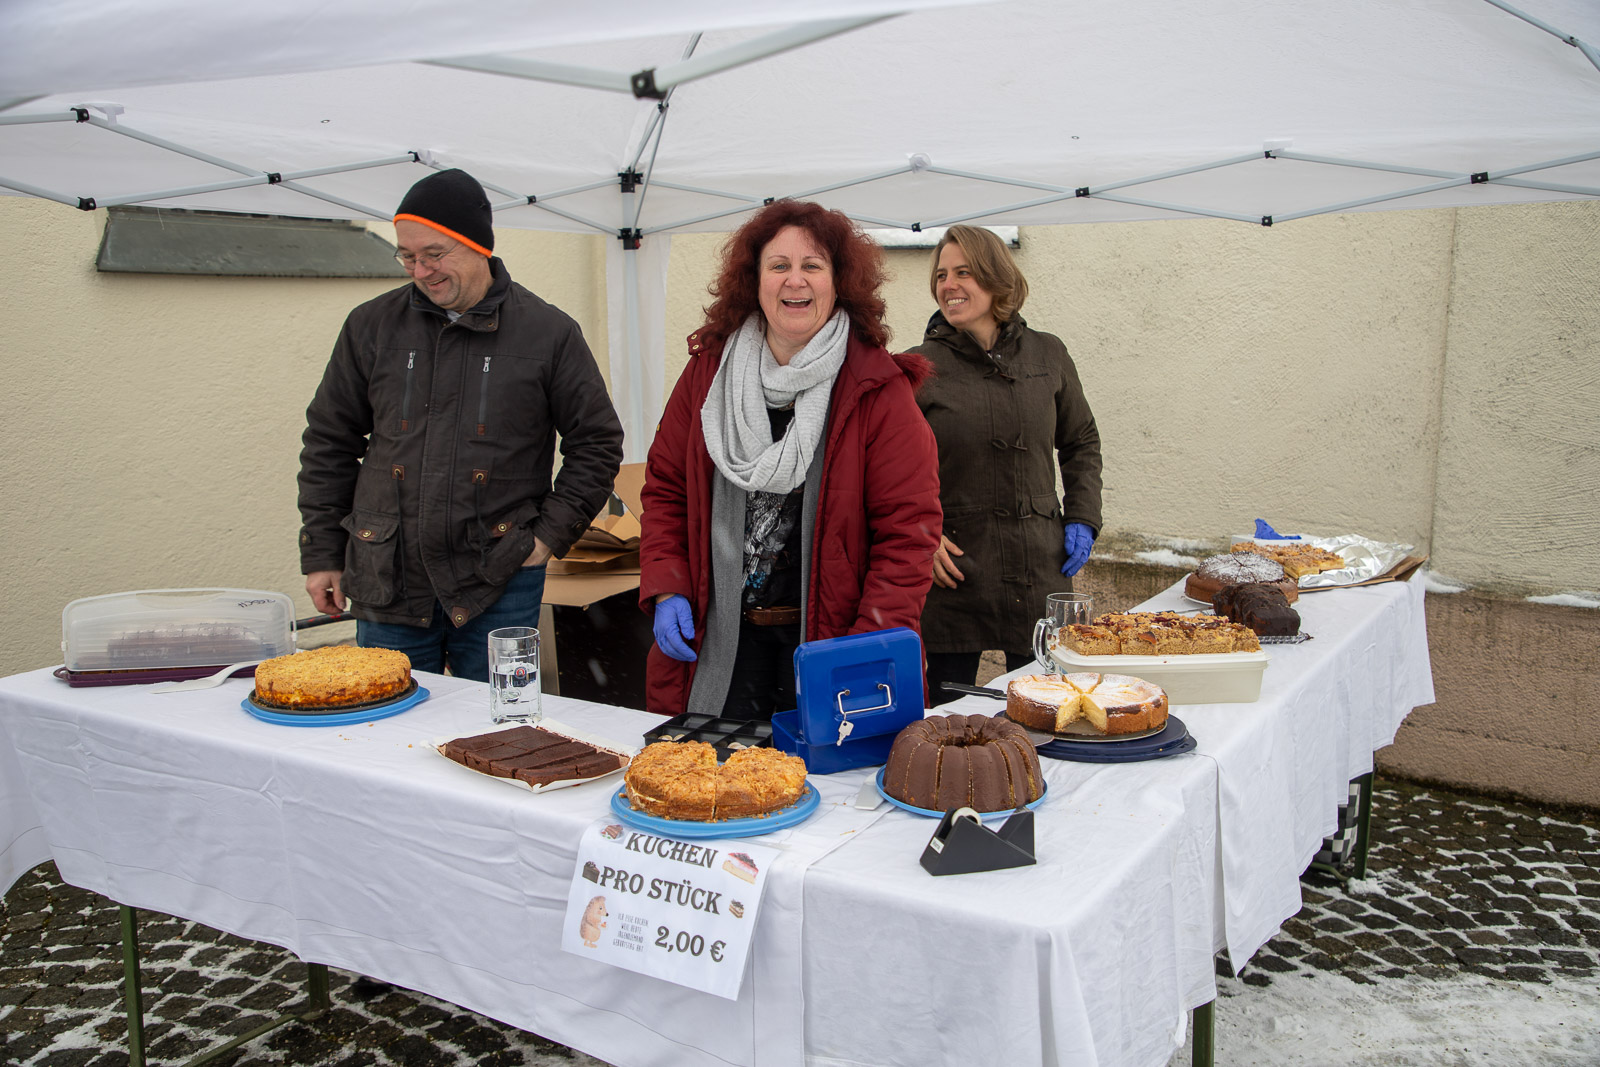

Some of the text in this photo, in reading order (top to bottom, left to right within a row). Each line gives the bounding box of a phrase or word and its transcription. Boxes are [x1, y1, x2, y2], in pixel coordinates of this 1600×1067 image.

[625, 832, 719, 869] KUCHEN
[600, 865, 723, 915] PRO STÜCK
[654, 925, 727, 963] 2,00 €
